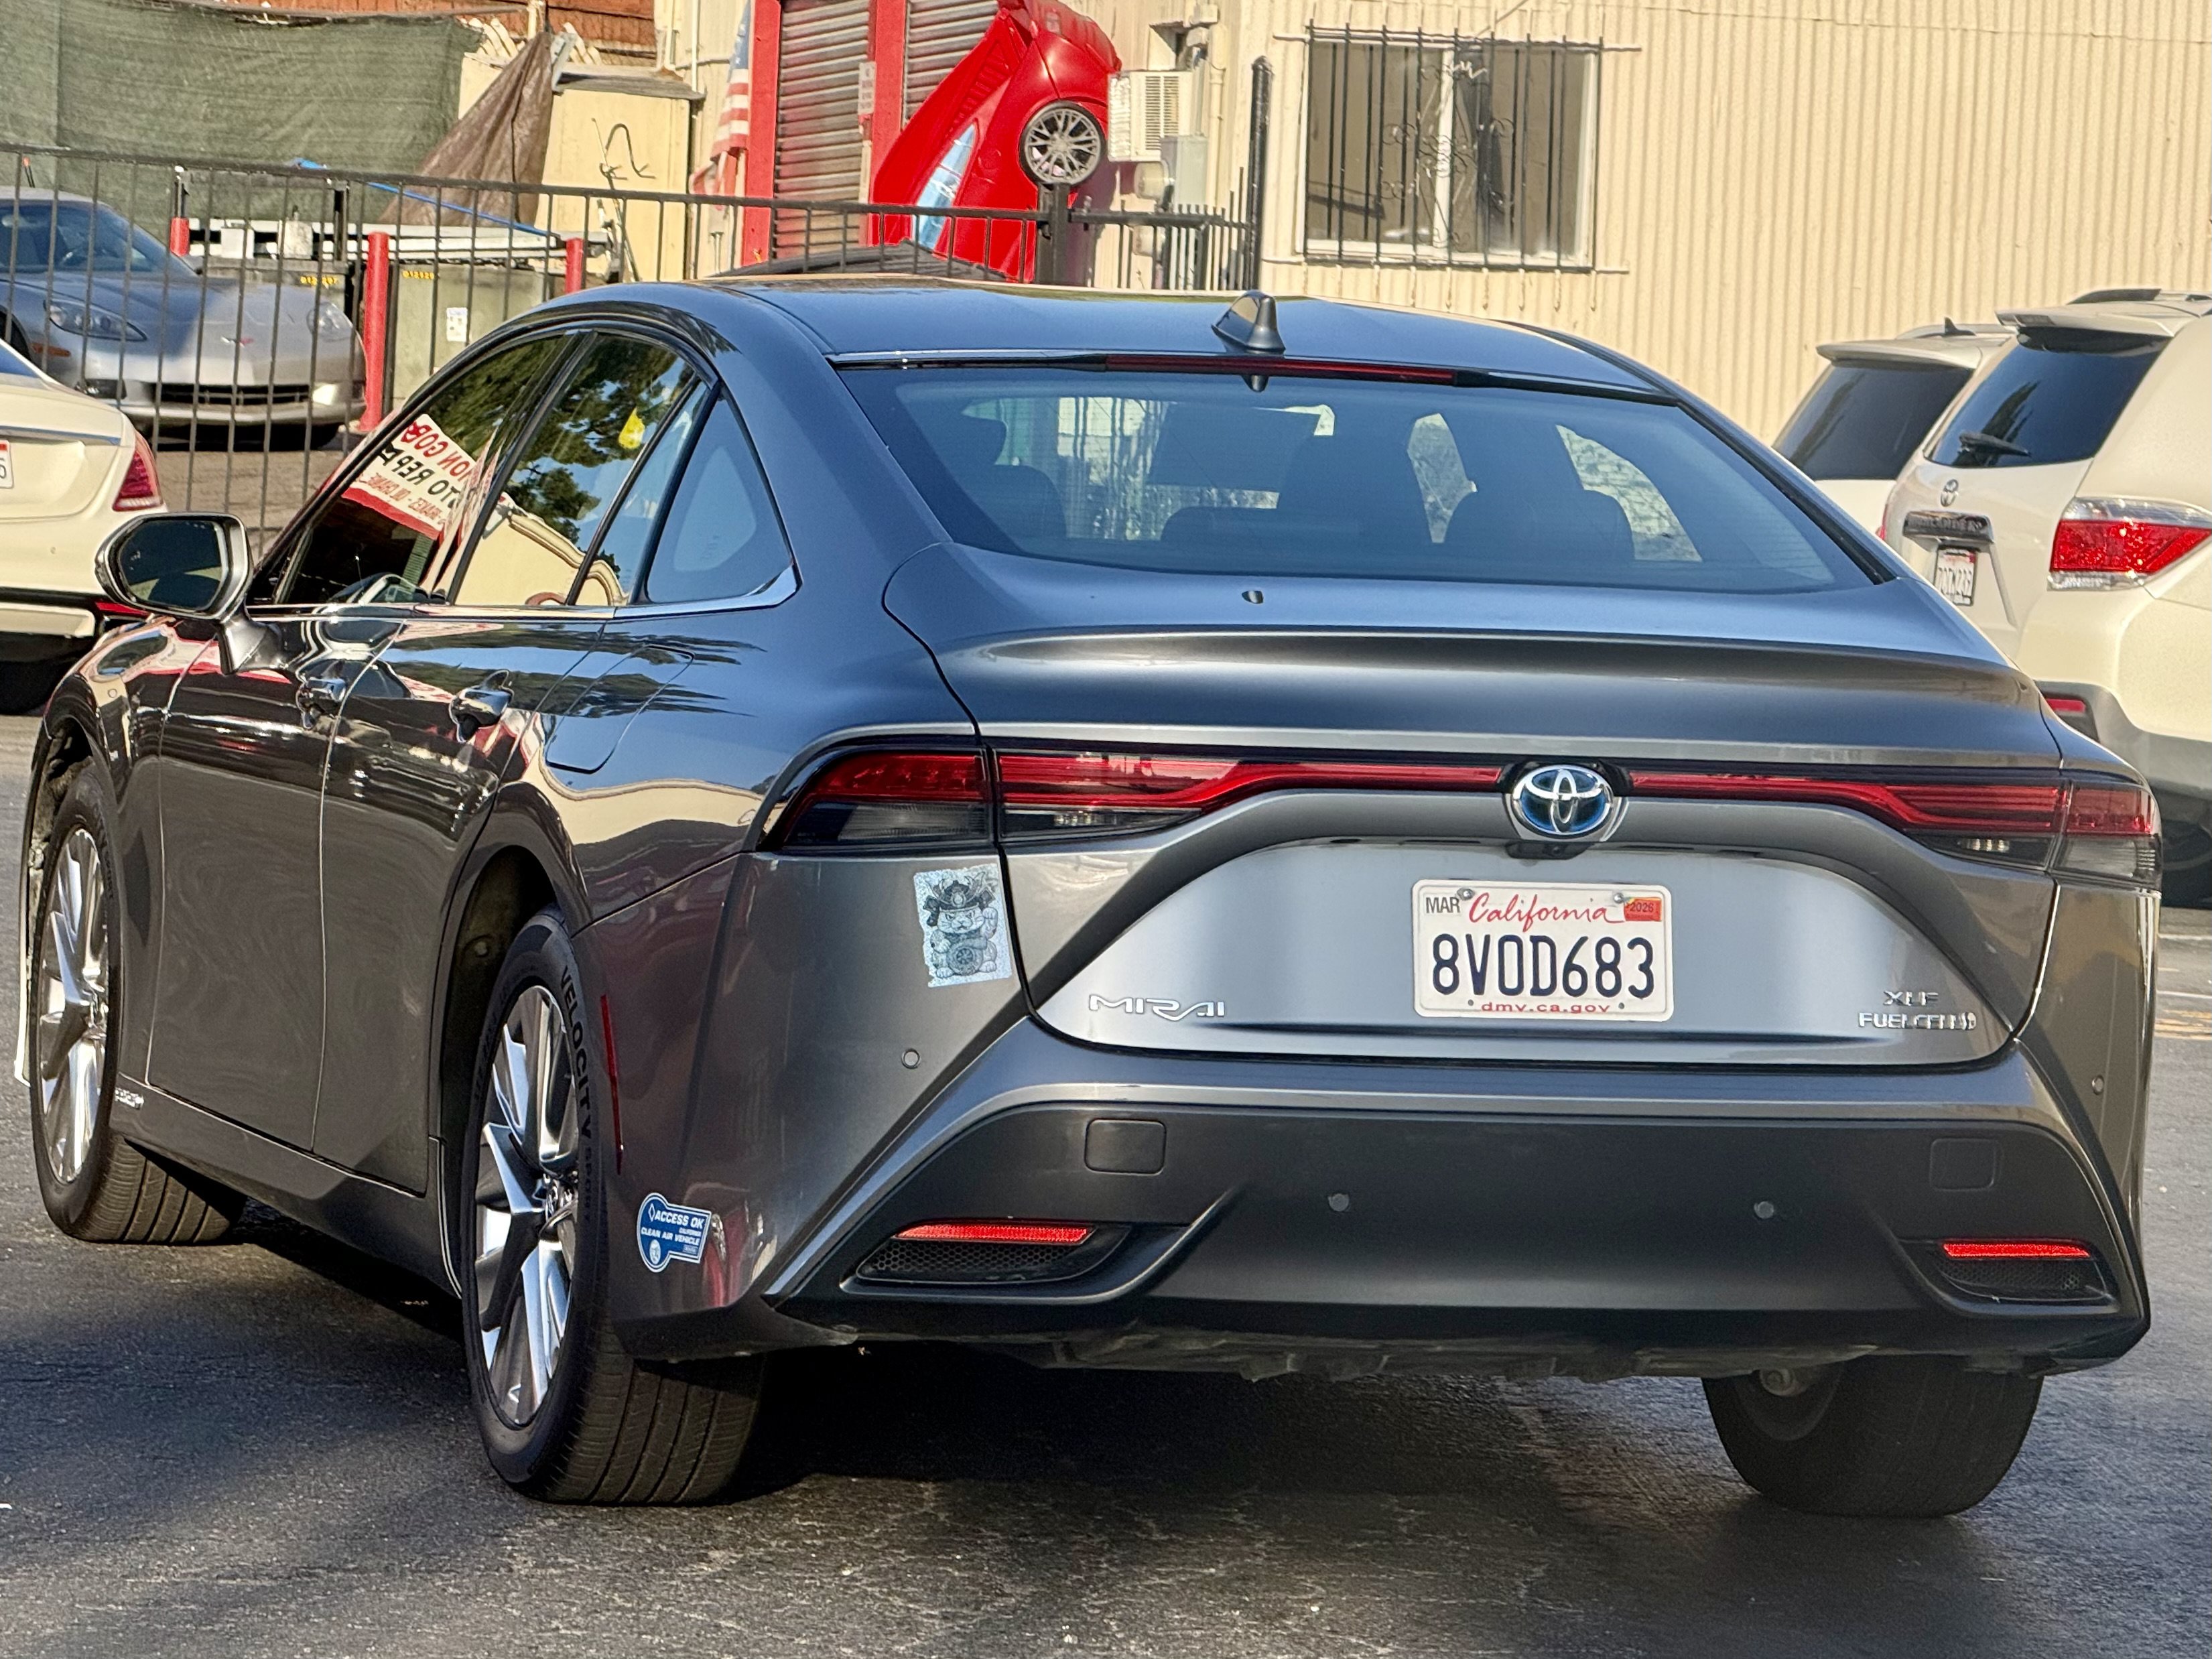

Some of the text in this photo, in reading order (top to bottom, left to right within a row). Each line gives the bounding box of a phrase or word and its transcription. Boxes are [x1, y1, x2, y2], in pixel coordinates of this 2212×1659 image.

[1426, 897, 1460, 913] MAR
[1468, 892, 1626, 933] California
[1630, 902, 1654, 912] 2026
[1432, 933, 1655, 999] 8VOD683
[1089, 994, 1226, 1021] MIRAI
[1481, 1002, 1610, 1014] dmv.ca.gov
[1858, 1012, 1912, 1028] FUEL
[560, 966, 592, 1139] VELOCITY
[655, 1210, 704, 1229] ACCESS OK
[641, 1227, 700, 1246] CLEAN AIR VEHICLE
